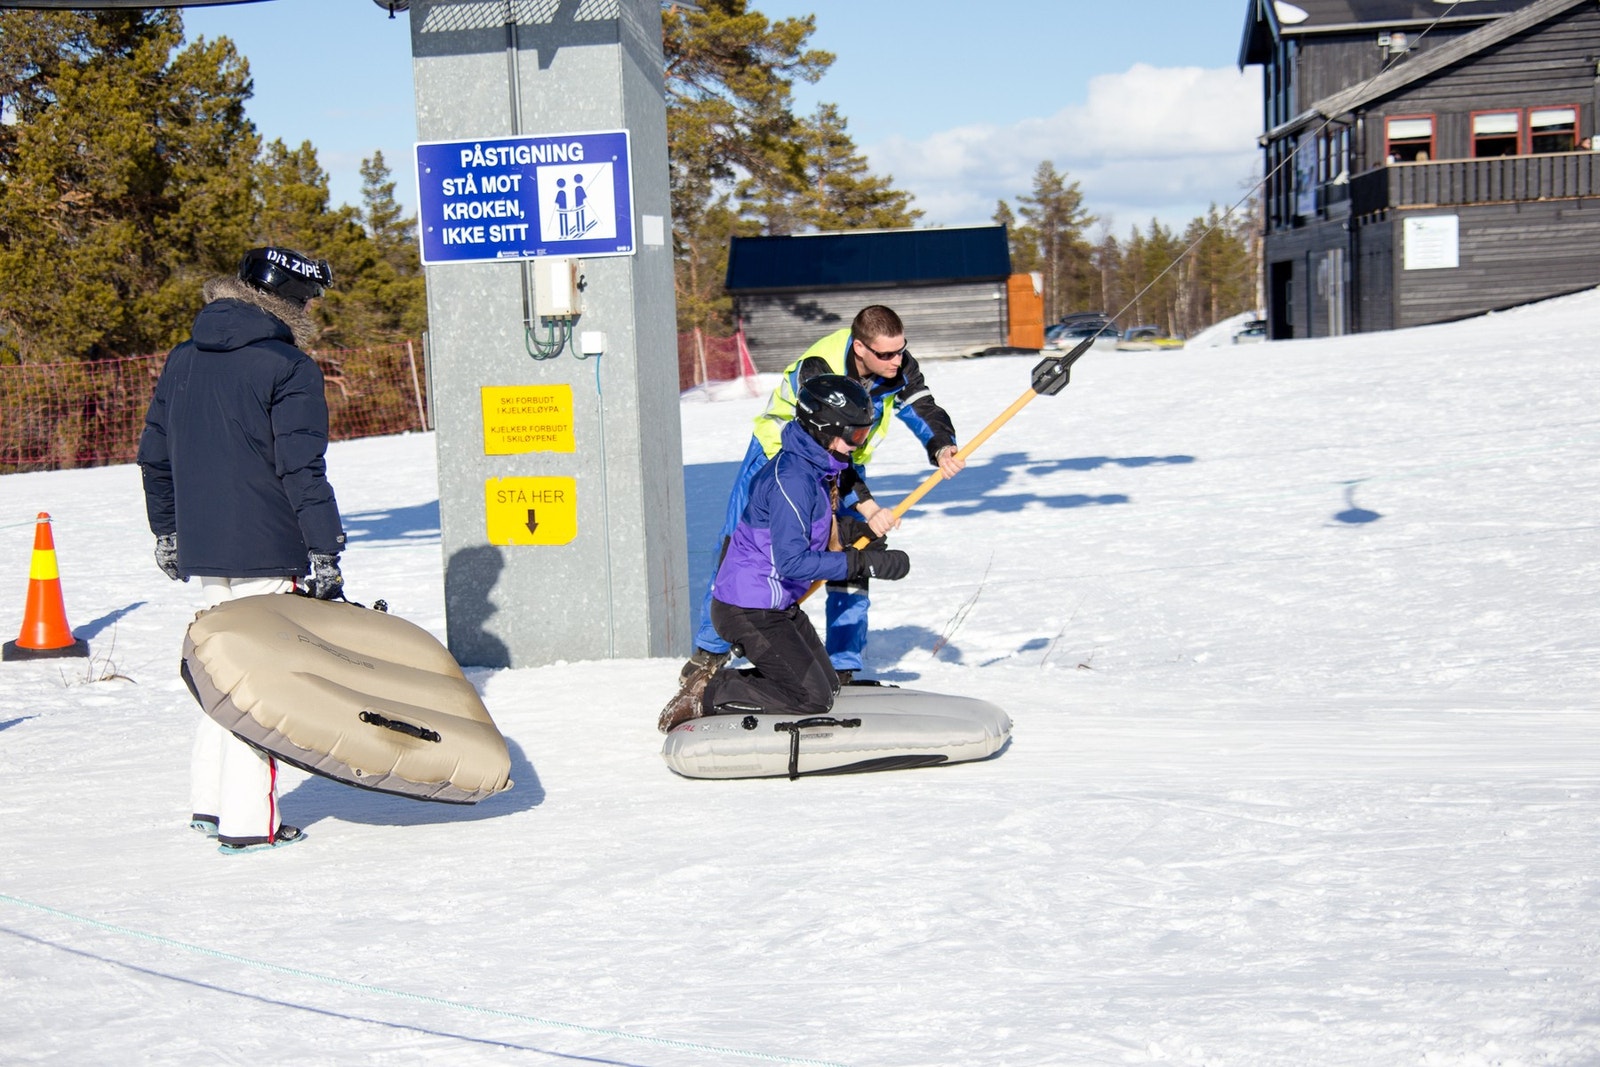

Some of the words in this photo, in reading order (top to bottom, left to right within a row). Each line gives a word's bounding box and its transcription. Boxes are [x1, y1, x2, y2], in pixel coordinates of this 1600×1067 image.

[461, 143, 584, 168] PÅSTIGNING
[442, 173, 478, 196] STÅ
[481, 175, 522, 194] MOT
[443, 199, 525, 221] KROKEN,
[442, 225, 486, 245] IKKE
[489, 224, 529, 243] SITT
[500, 397, 514, 405] SKI
[515, 396, 554, 404] FORBUDT
[490, 425, 528, 434] KJELKER
[529, 424, 568, 433] FORBUDT
[507, 434, 558, 443] SKILØYPENE
[531, 489, 565, 504] HER
